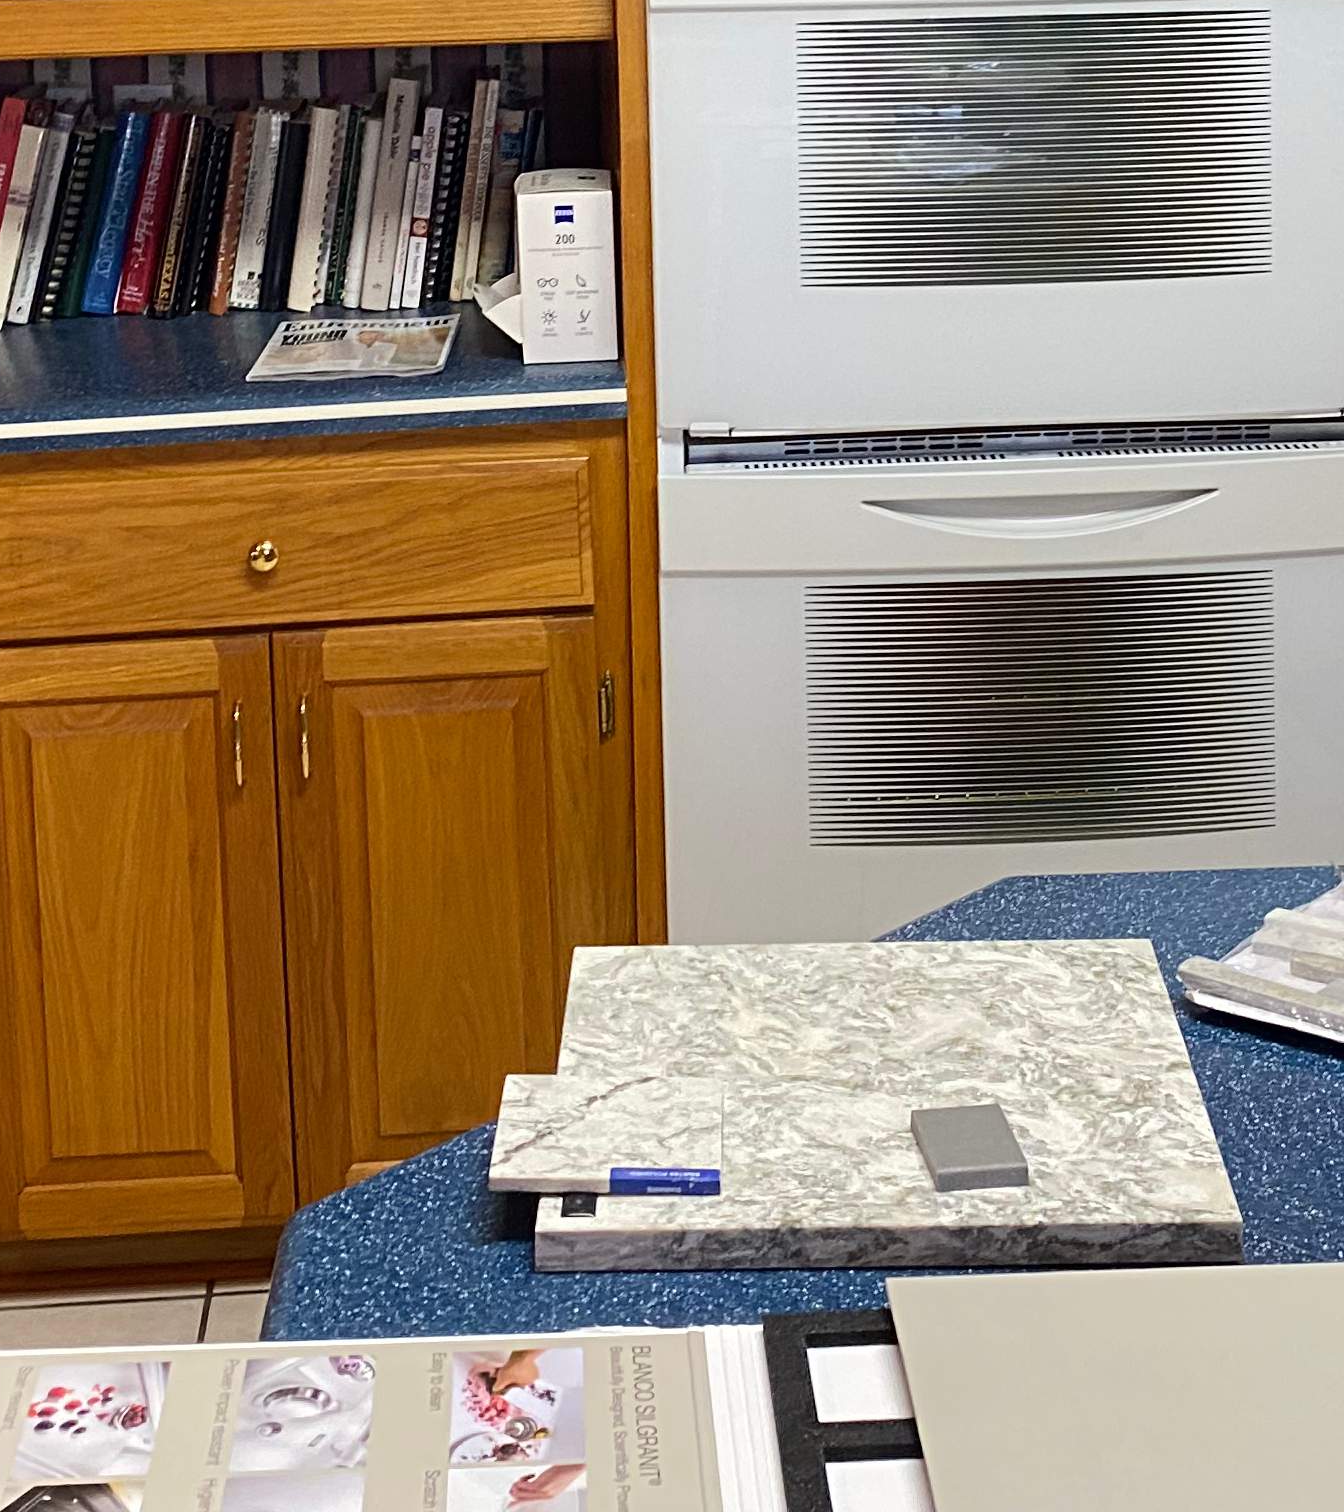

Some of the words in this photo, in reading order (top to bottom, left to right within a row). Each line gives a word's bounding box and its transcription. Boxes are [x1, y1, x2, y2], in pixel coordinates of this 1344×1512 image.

[421, 126, 436, 159] apple
[421, 162, 432, 180] pie
[555, 234, 575, 245] 200
[158, 255, 175, 300] TEXAS
[427, 1352, 447, 1373] Easy
[632, 1345, 655, 1401] BLANCO
[430, 1386, 444, 1411] clean
